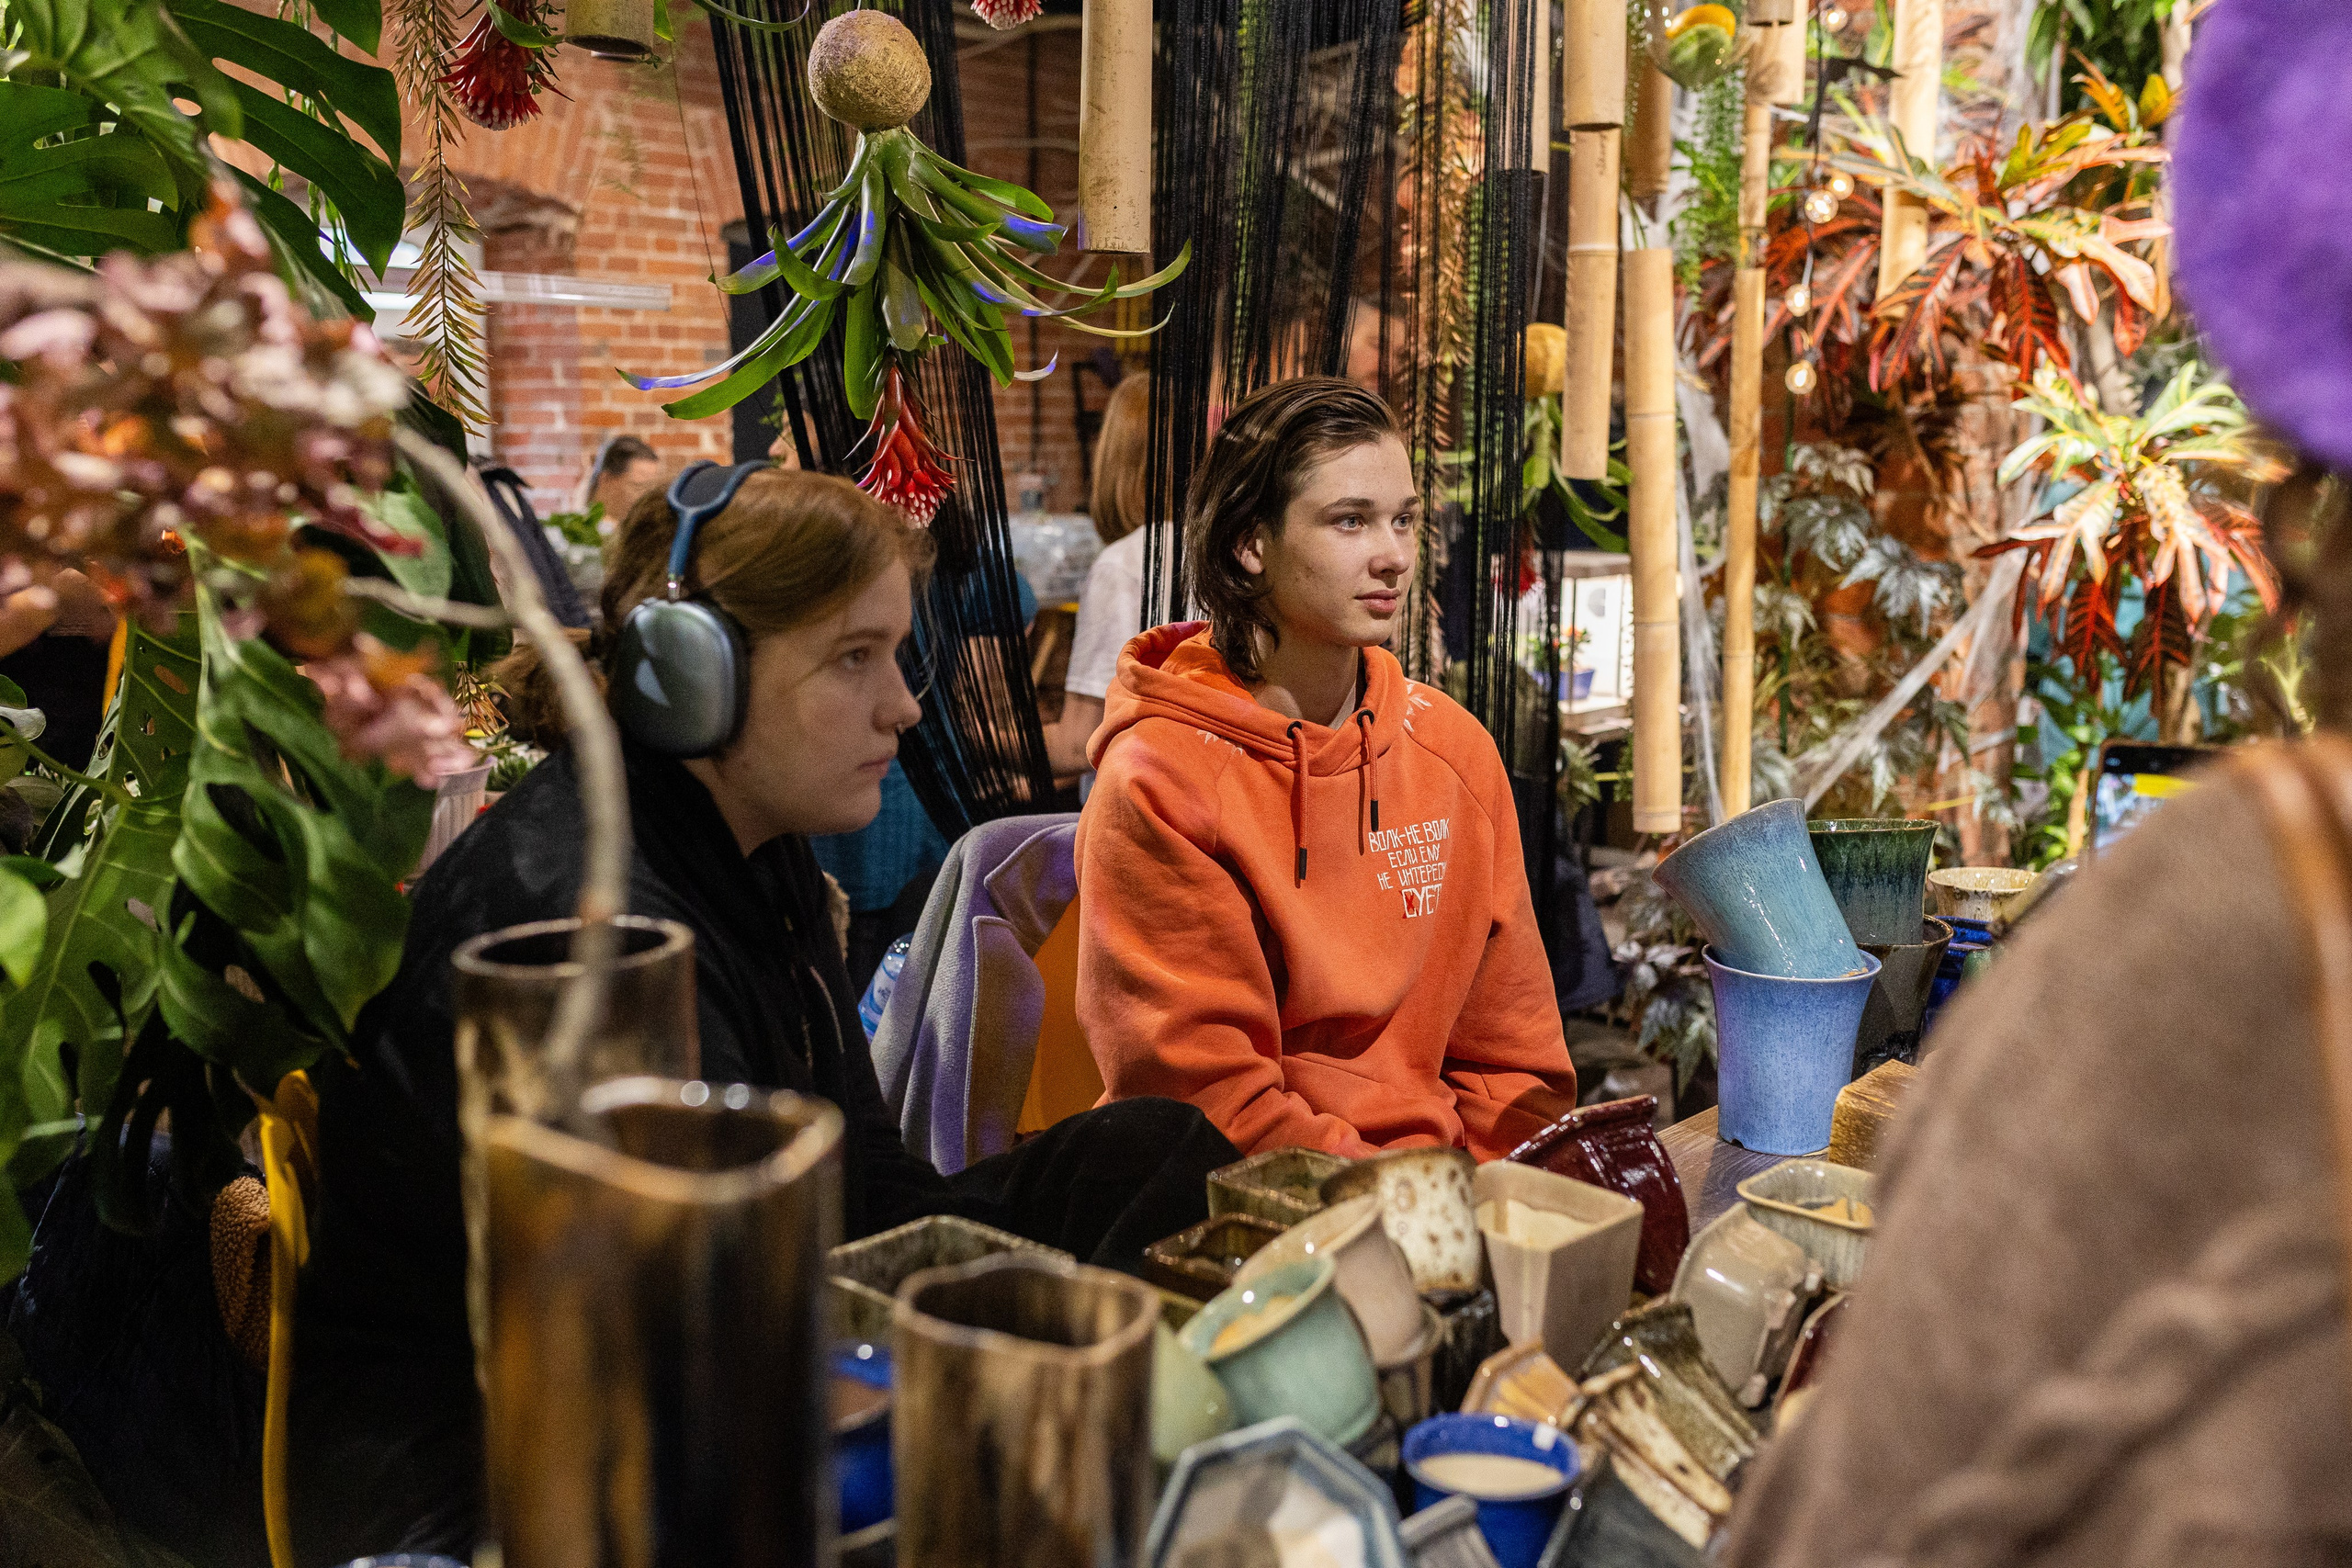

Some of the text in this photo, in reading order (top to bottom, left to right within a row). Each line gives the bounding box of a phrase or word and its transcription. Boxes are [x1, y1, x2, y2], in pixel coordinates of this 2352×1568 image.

[1422, 818, 1450, 842] ВОЛК
[1387, 843, 1441, 868] ЕСЛИ ЕМУ
[1376, 872, 1394, 891] НЕ
